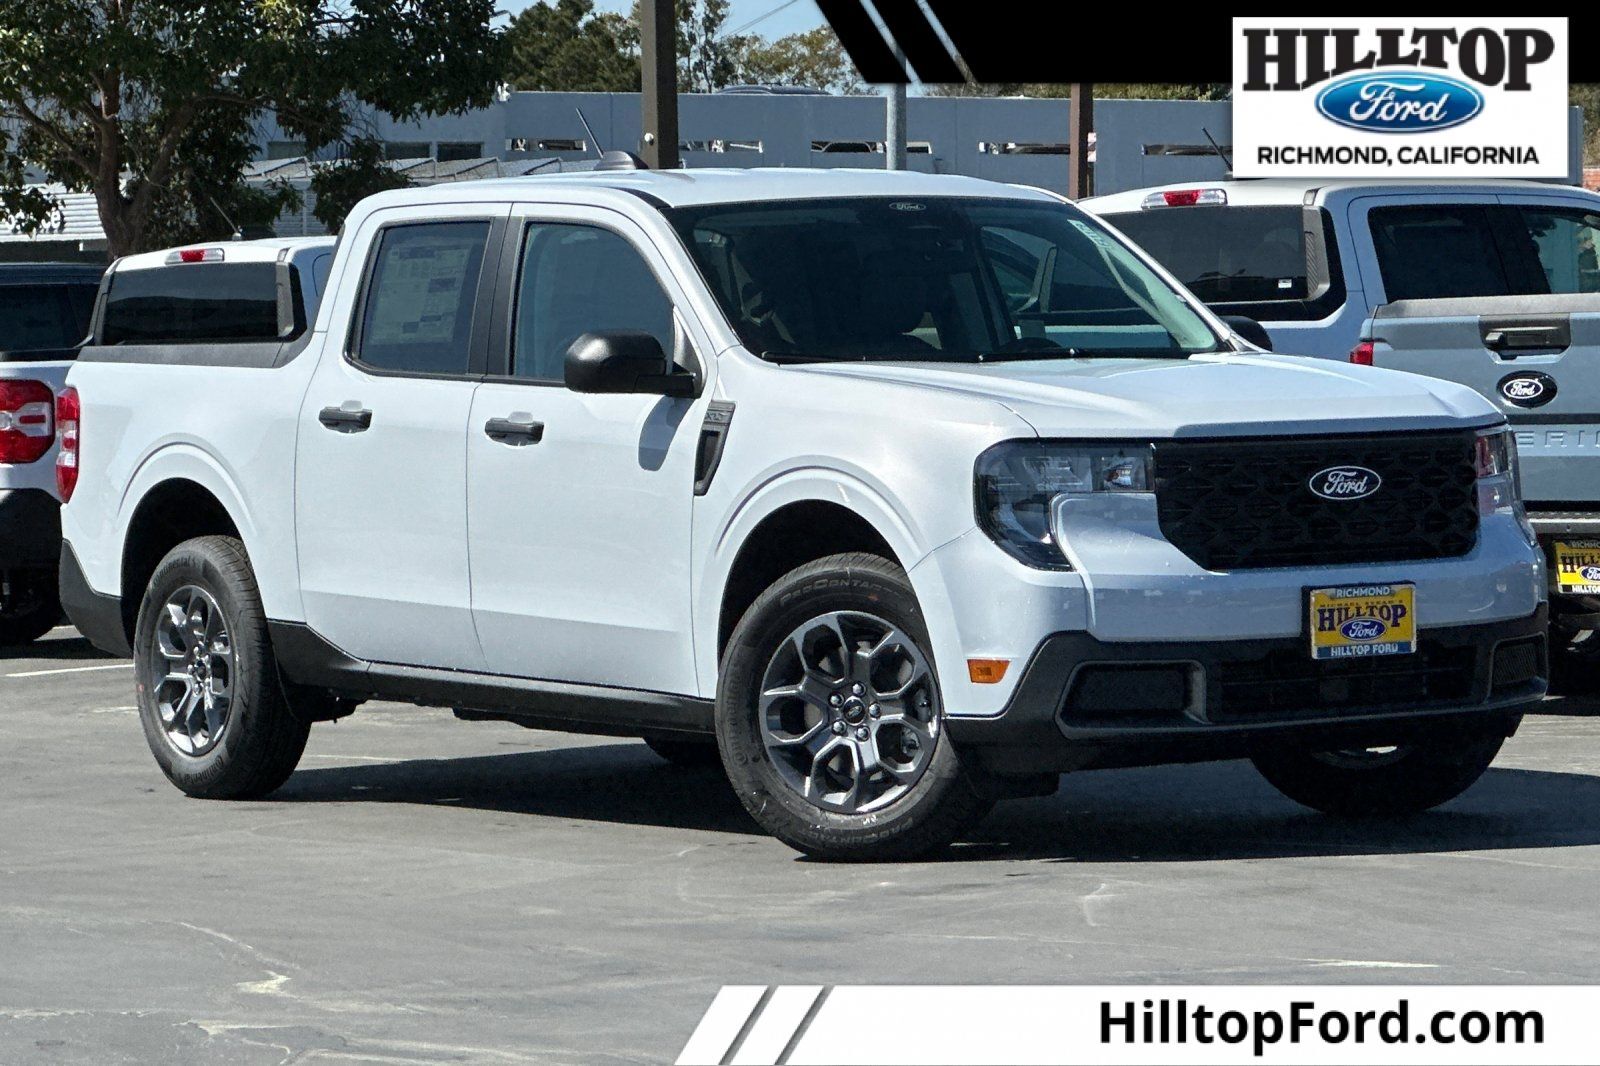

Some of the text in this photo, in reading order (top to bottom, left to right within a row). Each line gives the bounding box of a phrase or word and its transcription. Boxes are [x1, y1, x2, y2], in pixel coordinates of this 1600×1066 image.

[1510, 382, 1536, 396] Ford
[1323, 470, 1368, 495] Ford
[1336, 586, 1390, 598] RICHMOND
[1317, 604, 1407, 632] HILLTOP
[1348, 621, 1378, 637] Ford
[1331, 643, 1399, 656] HILLTOP FORD
